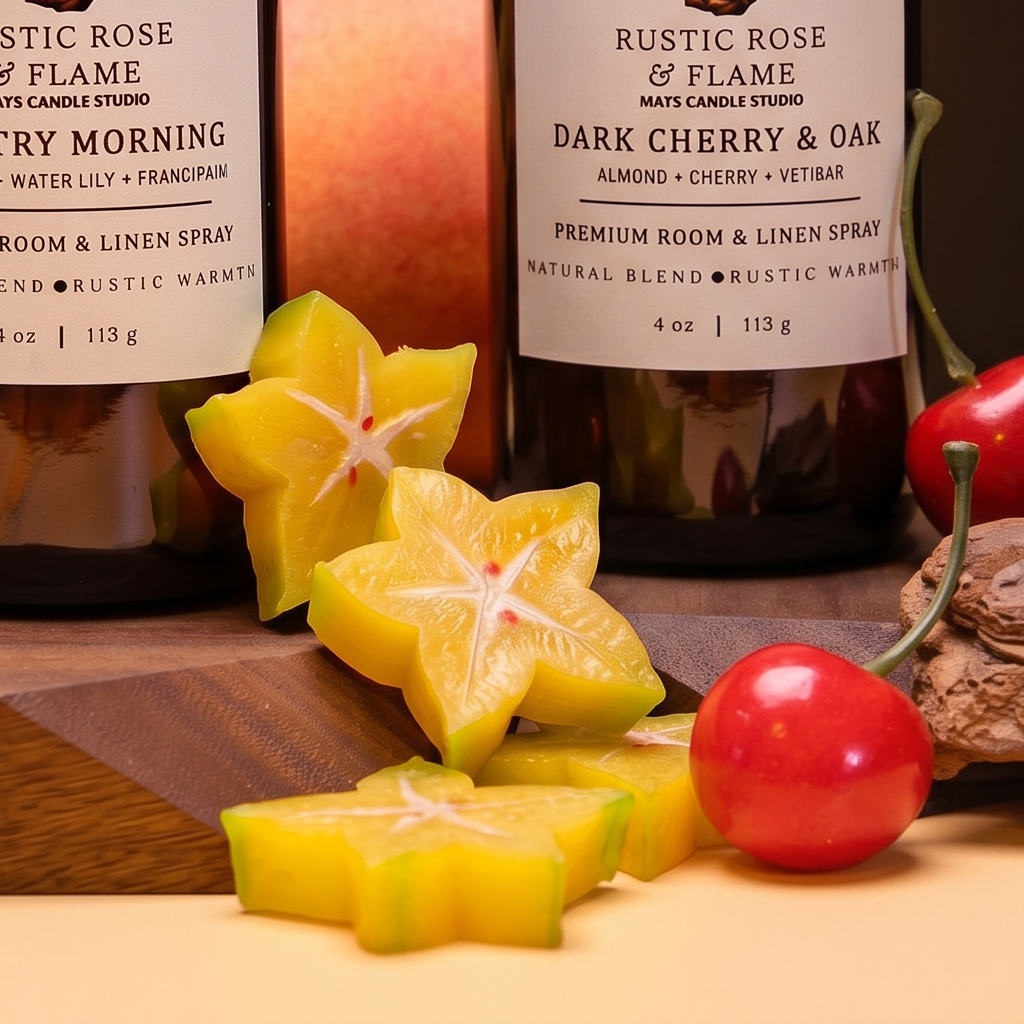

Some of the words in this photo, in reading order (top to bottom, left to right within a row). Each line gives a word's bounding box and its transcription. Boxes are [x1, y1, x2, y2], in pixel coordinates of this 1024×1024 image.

[89, 21, 173, 49] ROSE
[615, 28, 734, 52] RUSTIC
[747, 25, 826, 51] ROSE
[27, 60, 141, 87] FLAME
[648, 62, 675, 88] &
[687, 62, 796, 87] FLAME
[26, 94, 91, 109] CANDLE
[93, 92, 151, 108] STUDIO
[639, 95, 682, 109] MAYS
[685, 95, 747, 109] CANDLE
[750, 93, 804, 108] STUDIO
[70, 120, 226, 156] MORNING
[553, 122, 635, 152] DARK
[648, 126, 785, 154] CHERRY
[796, 125, 819, 151] &
[829, 119, 882, 149] OAK
[10, 173, 73, 190] WATER
[79, 171, 116, 189] LILY
[121, 173, 132, 185] +
[597, 166, 668, 185] ALMOND
[674, 172, 683, 183] +
[689, 168, 758, 186] CHERRY
[764, 171, 773, 182] +
[779, 164, 844, 184] VETIBAR
[75, 235, 91, 252] &
[99, 231, 170, 252] LINEN
[178, 224, 234, 247] SPRAY
[554, 221, 649, 245] PREMIUM
[657, 228, 724, 246] ROOM
[732, 228, 748, 246] &
[756, 225, 822, 245] LINEN
[828, 219, 882, 241] SPRAY
[73, 275, 163, 293] RUSTIC
[527, 258, 613, 281] NATURAL
[626, 268, 702, 284] BLEND
[730, 266, 816, 284] RUSTIC
[13, 331, 36, 344] oz
[87, 326, 119, 343] 113
[126, 328, 138, 347] g
[653, 316, 665, 332] 4
[671, 320, 694, 333] oz
[743, 315, 774, 333] 113
[780, 319, 791, 336] g
